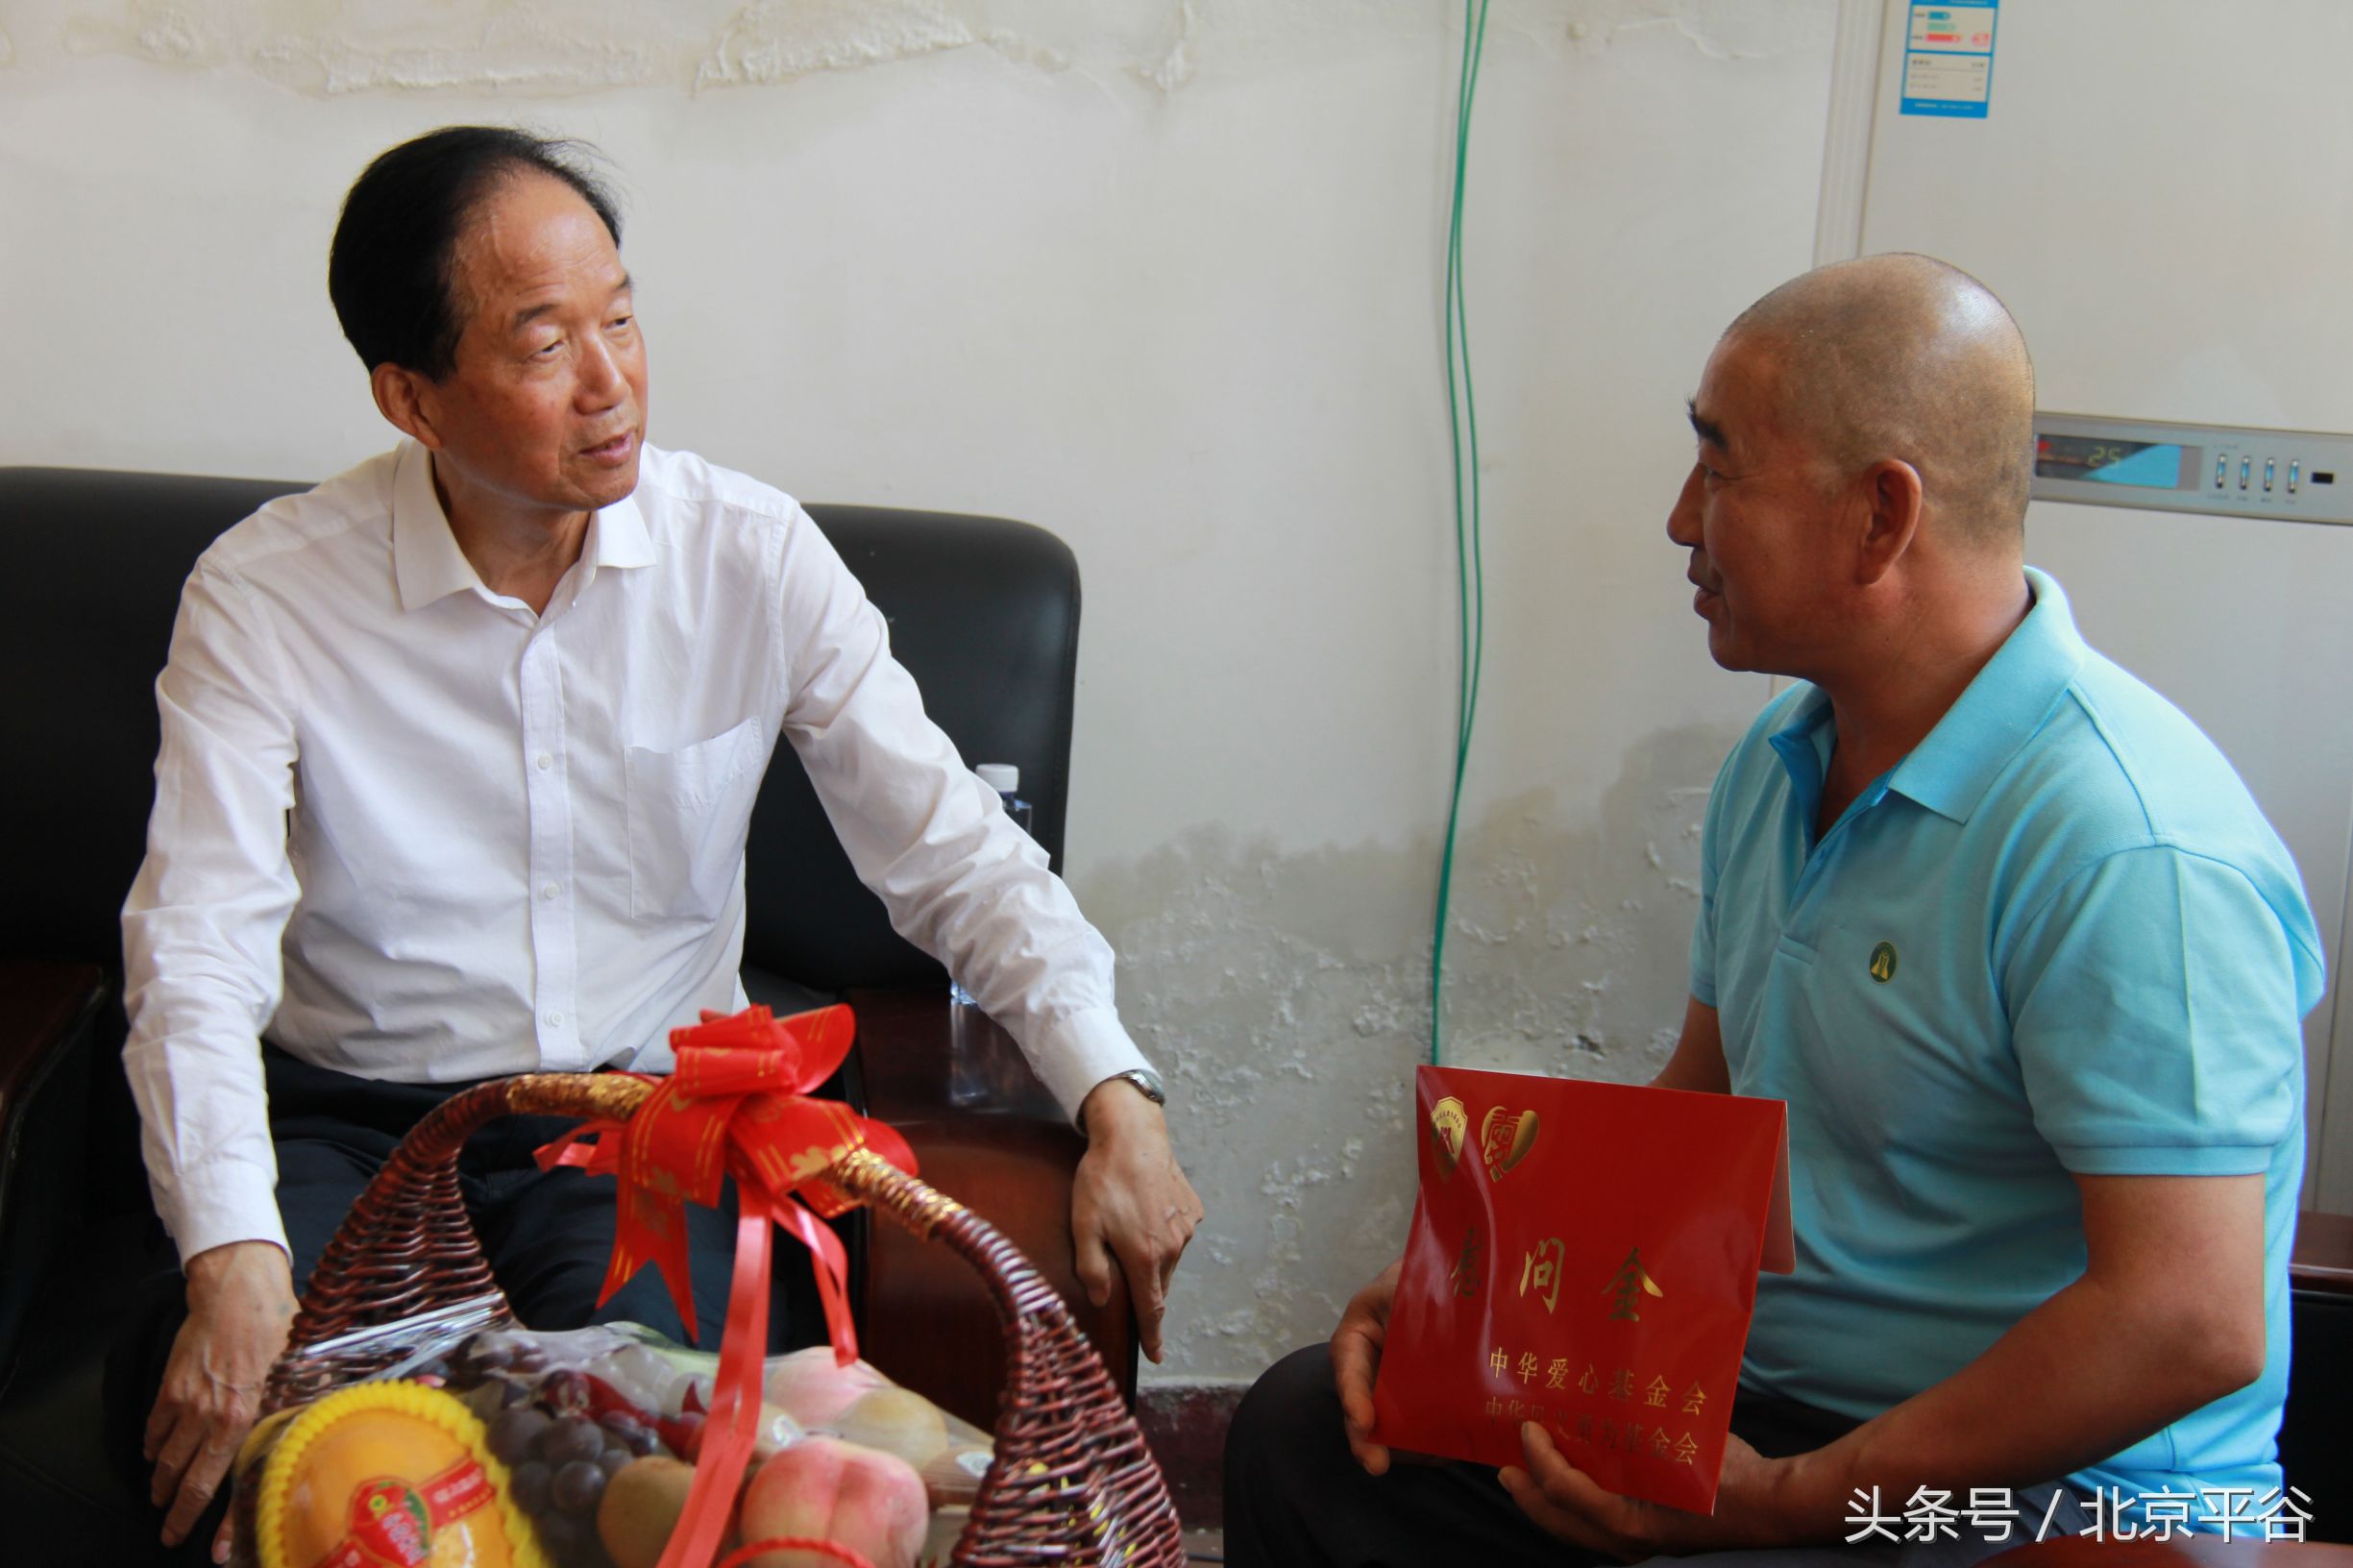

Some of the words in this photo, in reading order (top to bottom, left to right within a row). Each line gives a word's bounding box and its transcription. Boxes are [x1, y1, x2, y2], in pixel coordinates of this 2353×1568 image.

[2088, 446, 2122, 468] 25
[1450, 1227, 1664, 1323] 慰问金
[1489, 1346, 1707, 1416] 中华爱心基金会
